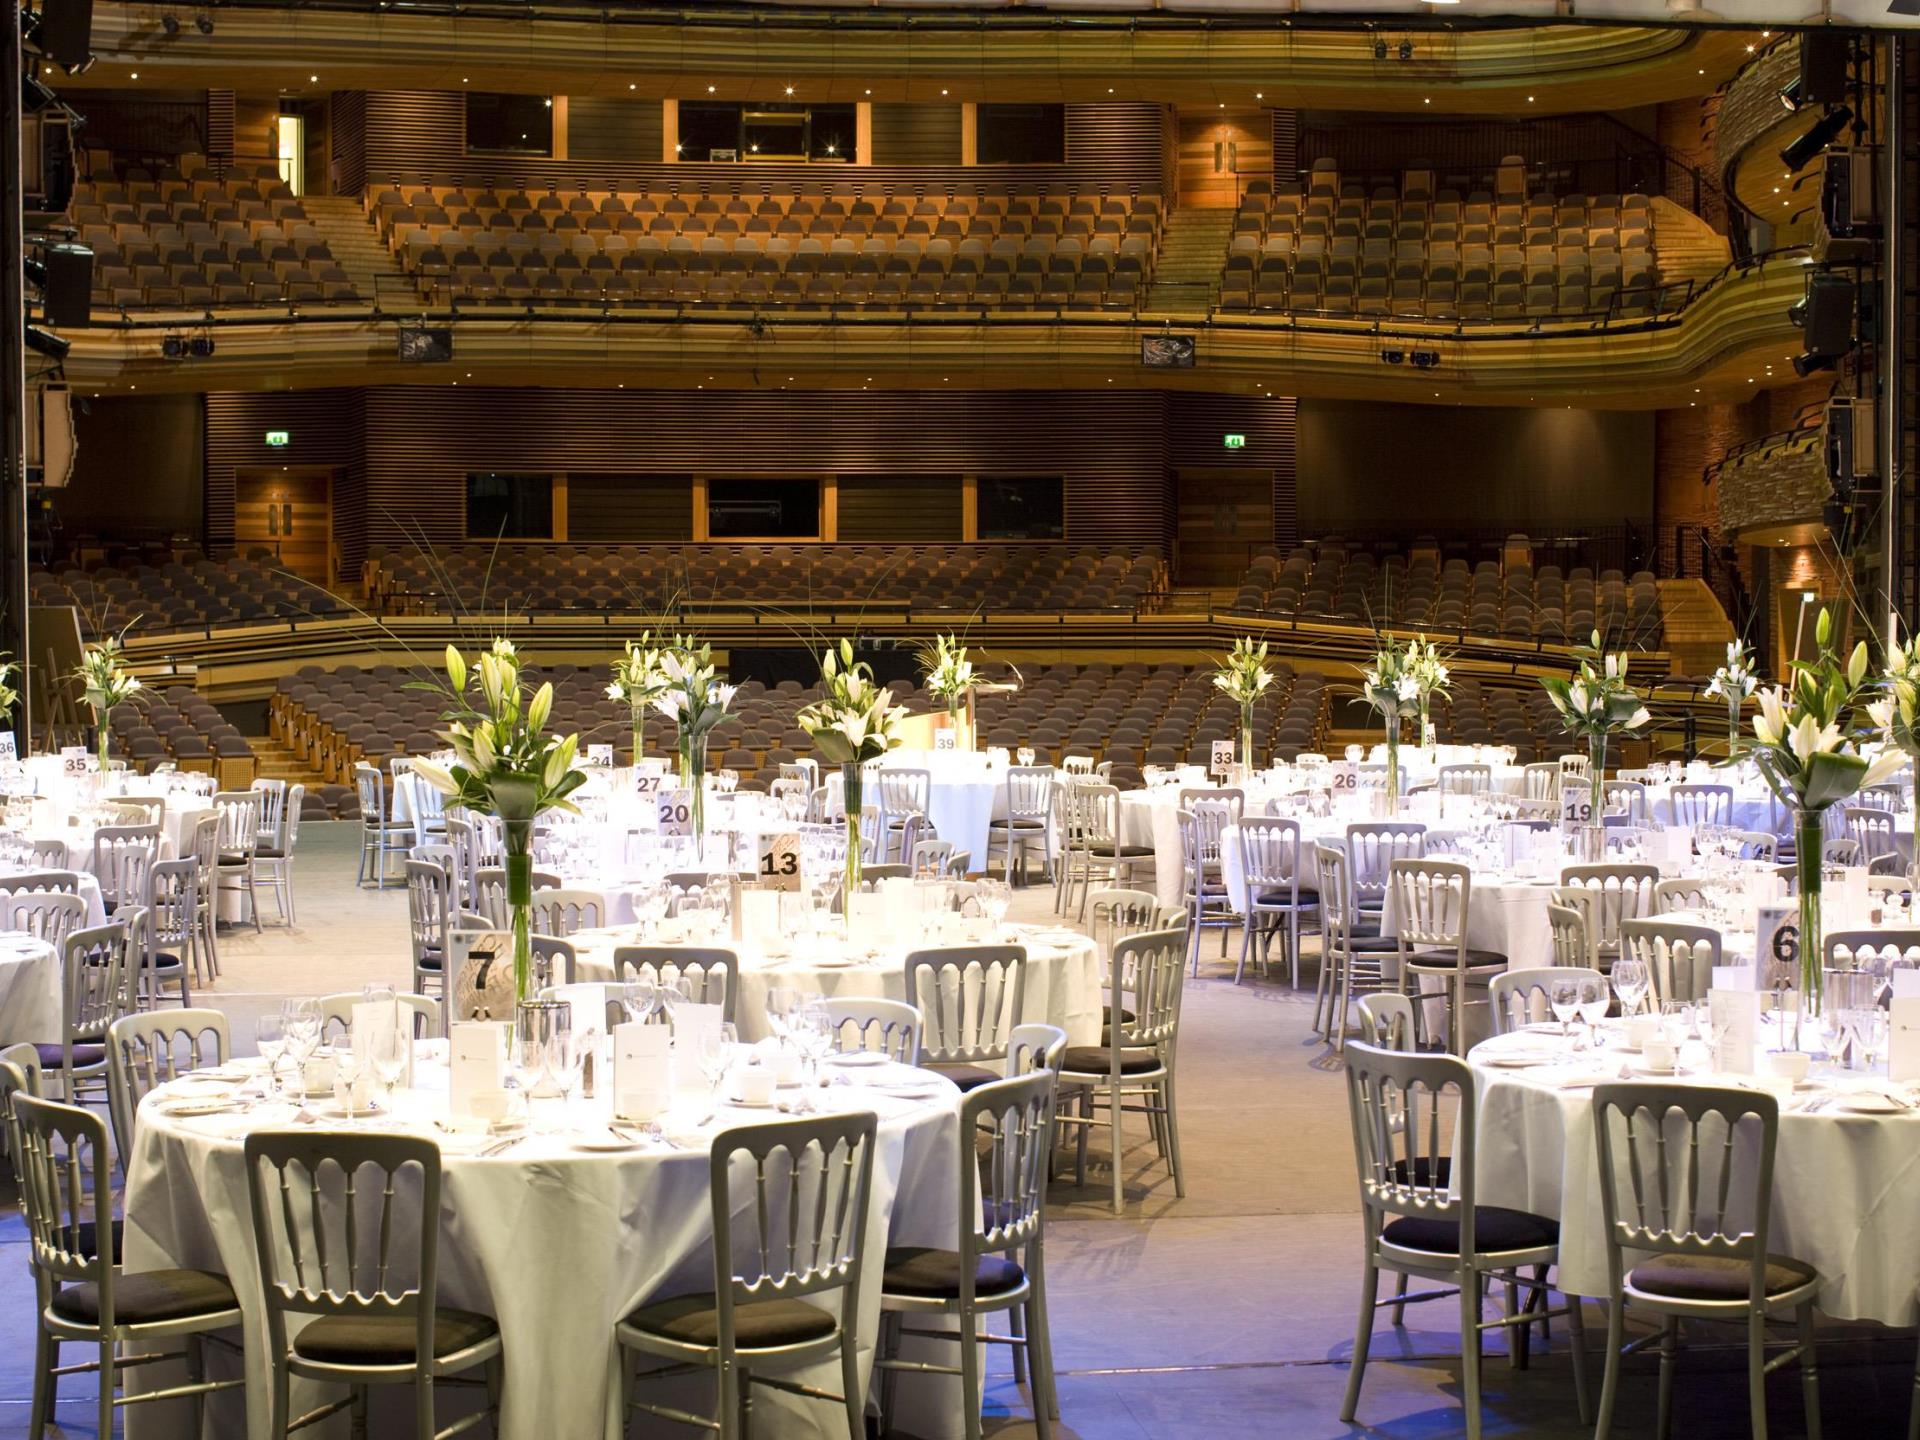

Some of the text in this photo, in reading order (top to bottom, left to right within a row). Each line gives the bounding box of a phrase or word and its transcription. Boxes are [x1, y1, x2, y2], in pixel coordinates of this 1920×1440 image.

[0, 743, 14, 754] 36
[938, 739, 954, 749] 39
[66, 759, 86, 771] 35
[1214, 752, 1232, 764] 33
[638, 778, 660, 792] 27
[1335, 774, 1356, 788] 26
[660, 805, 689, 823] 20
[1565, 804, 1592, 821] 19
[761, 853, 798, 876] 13
[1772, 926, 1799, 962] 6
[468, 952, 495, 990] 7
